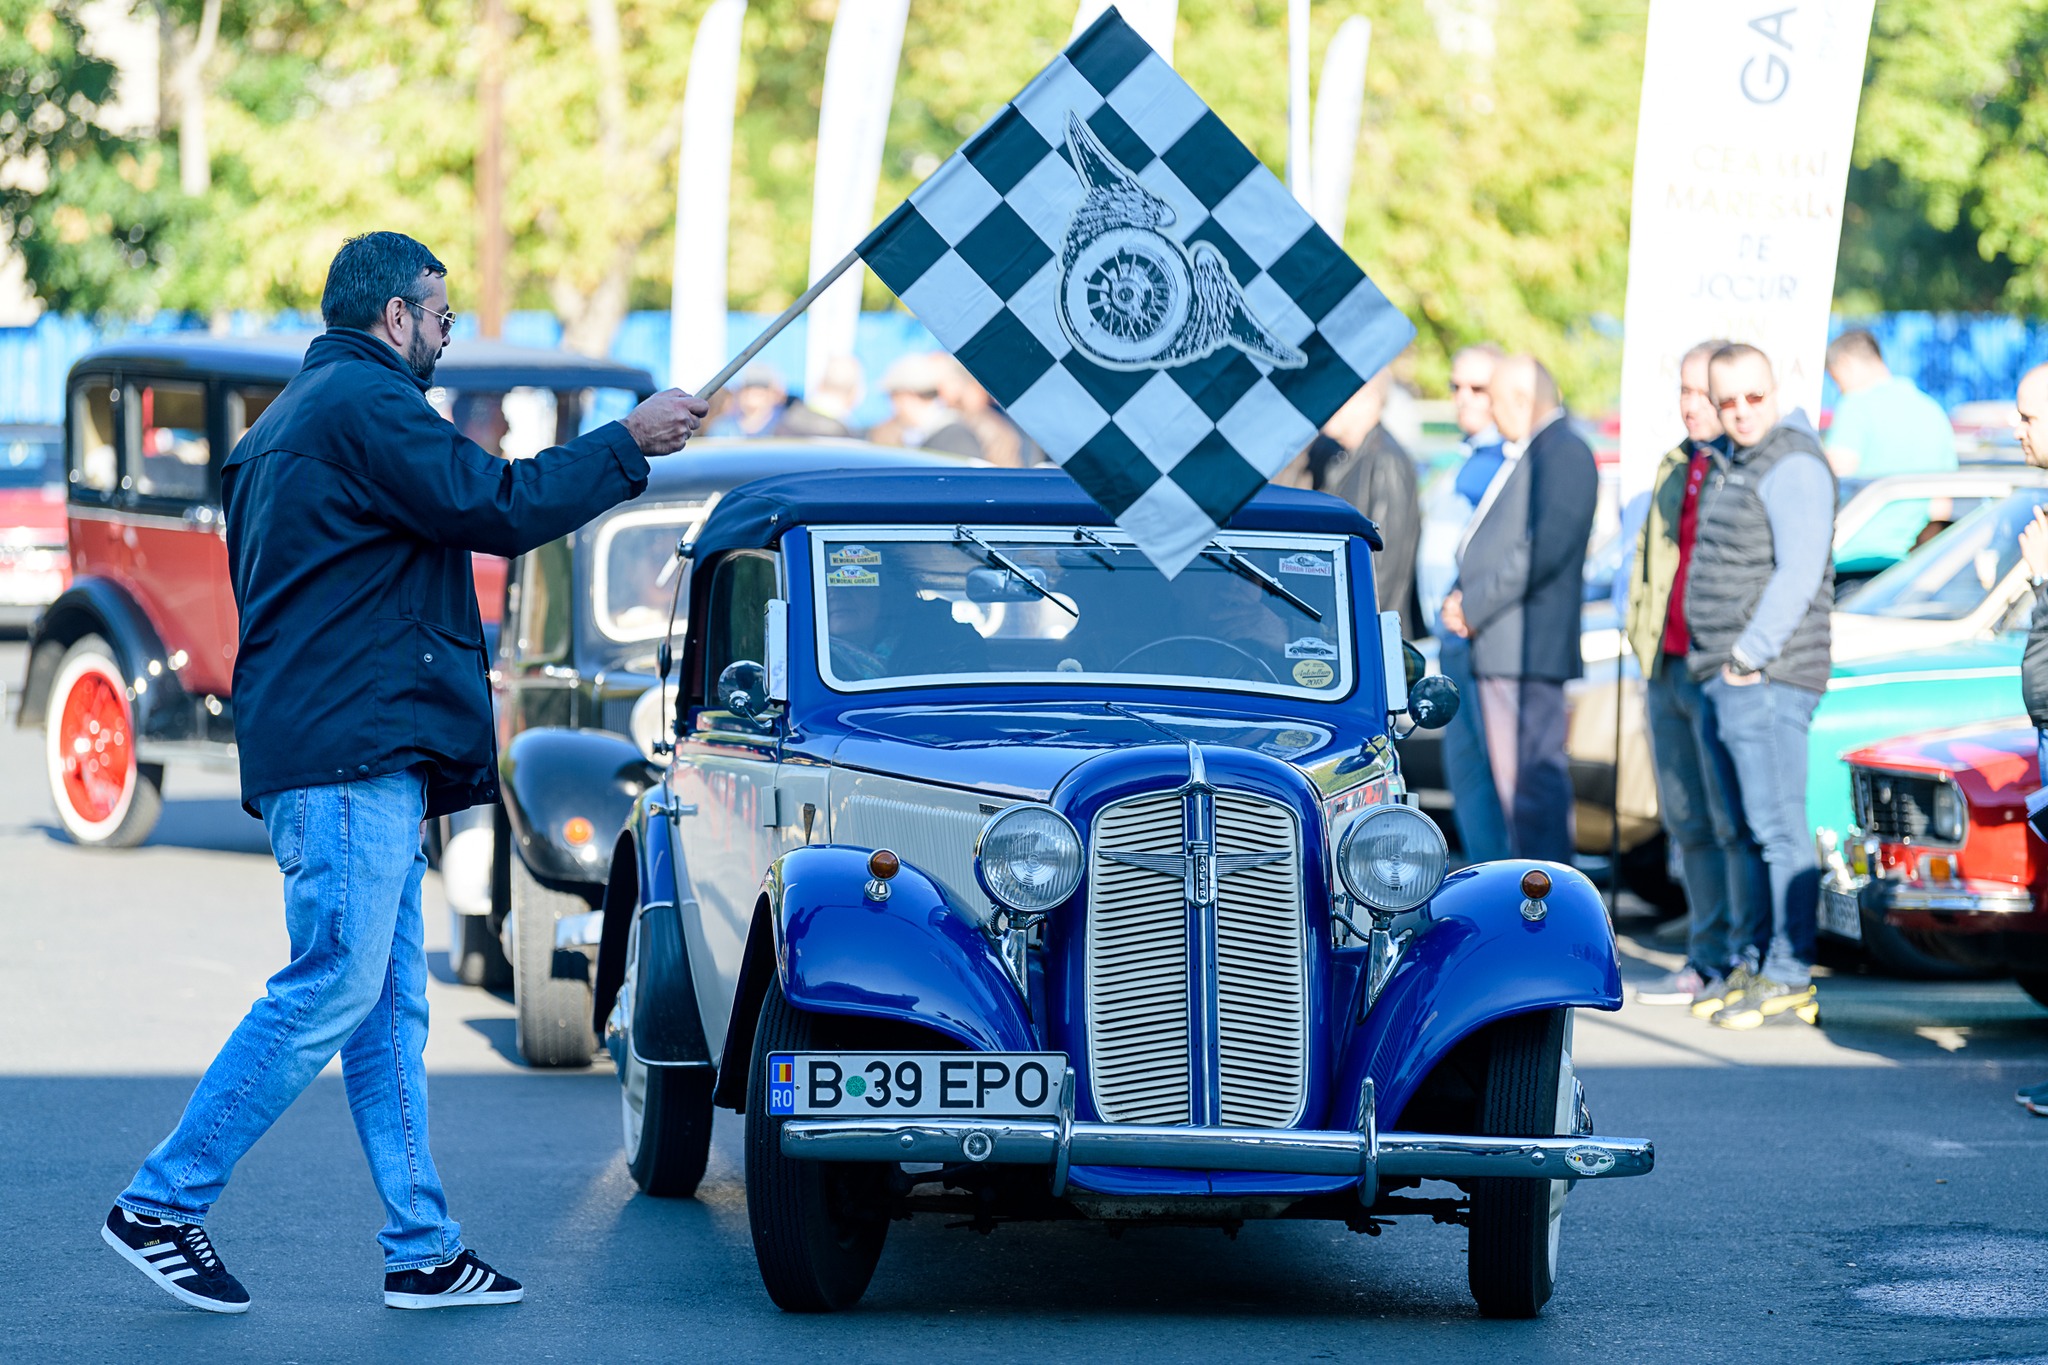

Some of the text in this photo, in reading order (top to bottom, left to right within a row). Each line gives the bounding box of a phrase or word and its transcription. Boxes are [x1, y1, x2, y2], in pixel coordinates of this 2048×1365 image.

[771, 1089, 793, 1108] RO
[808, 1061, 1049, 1108] B 39 EPO
